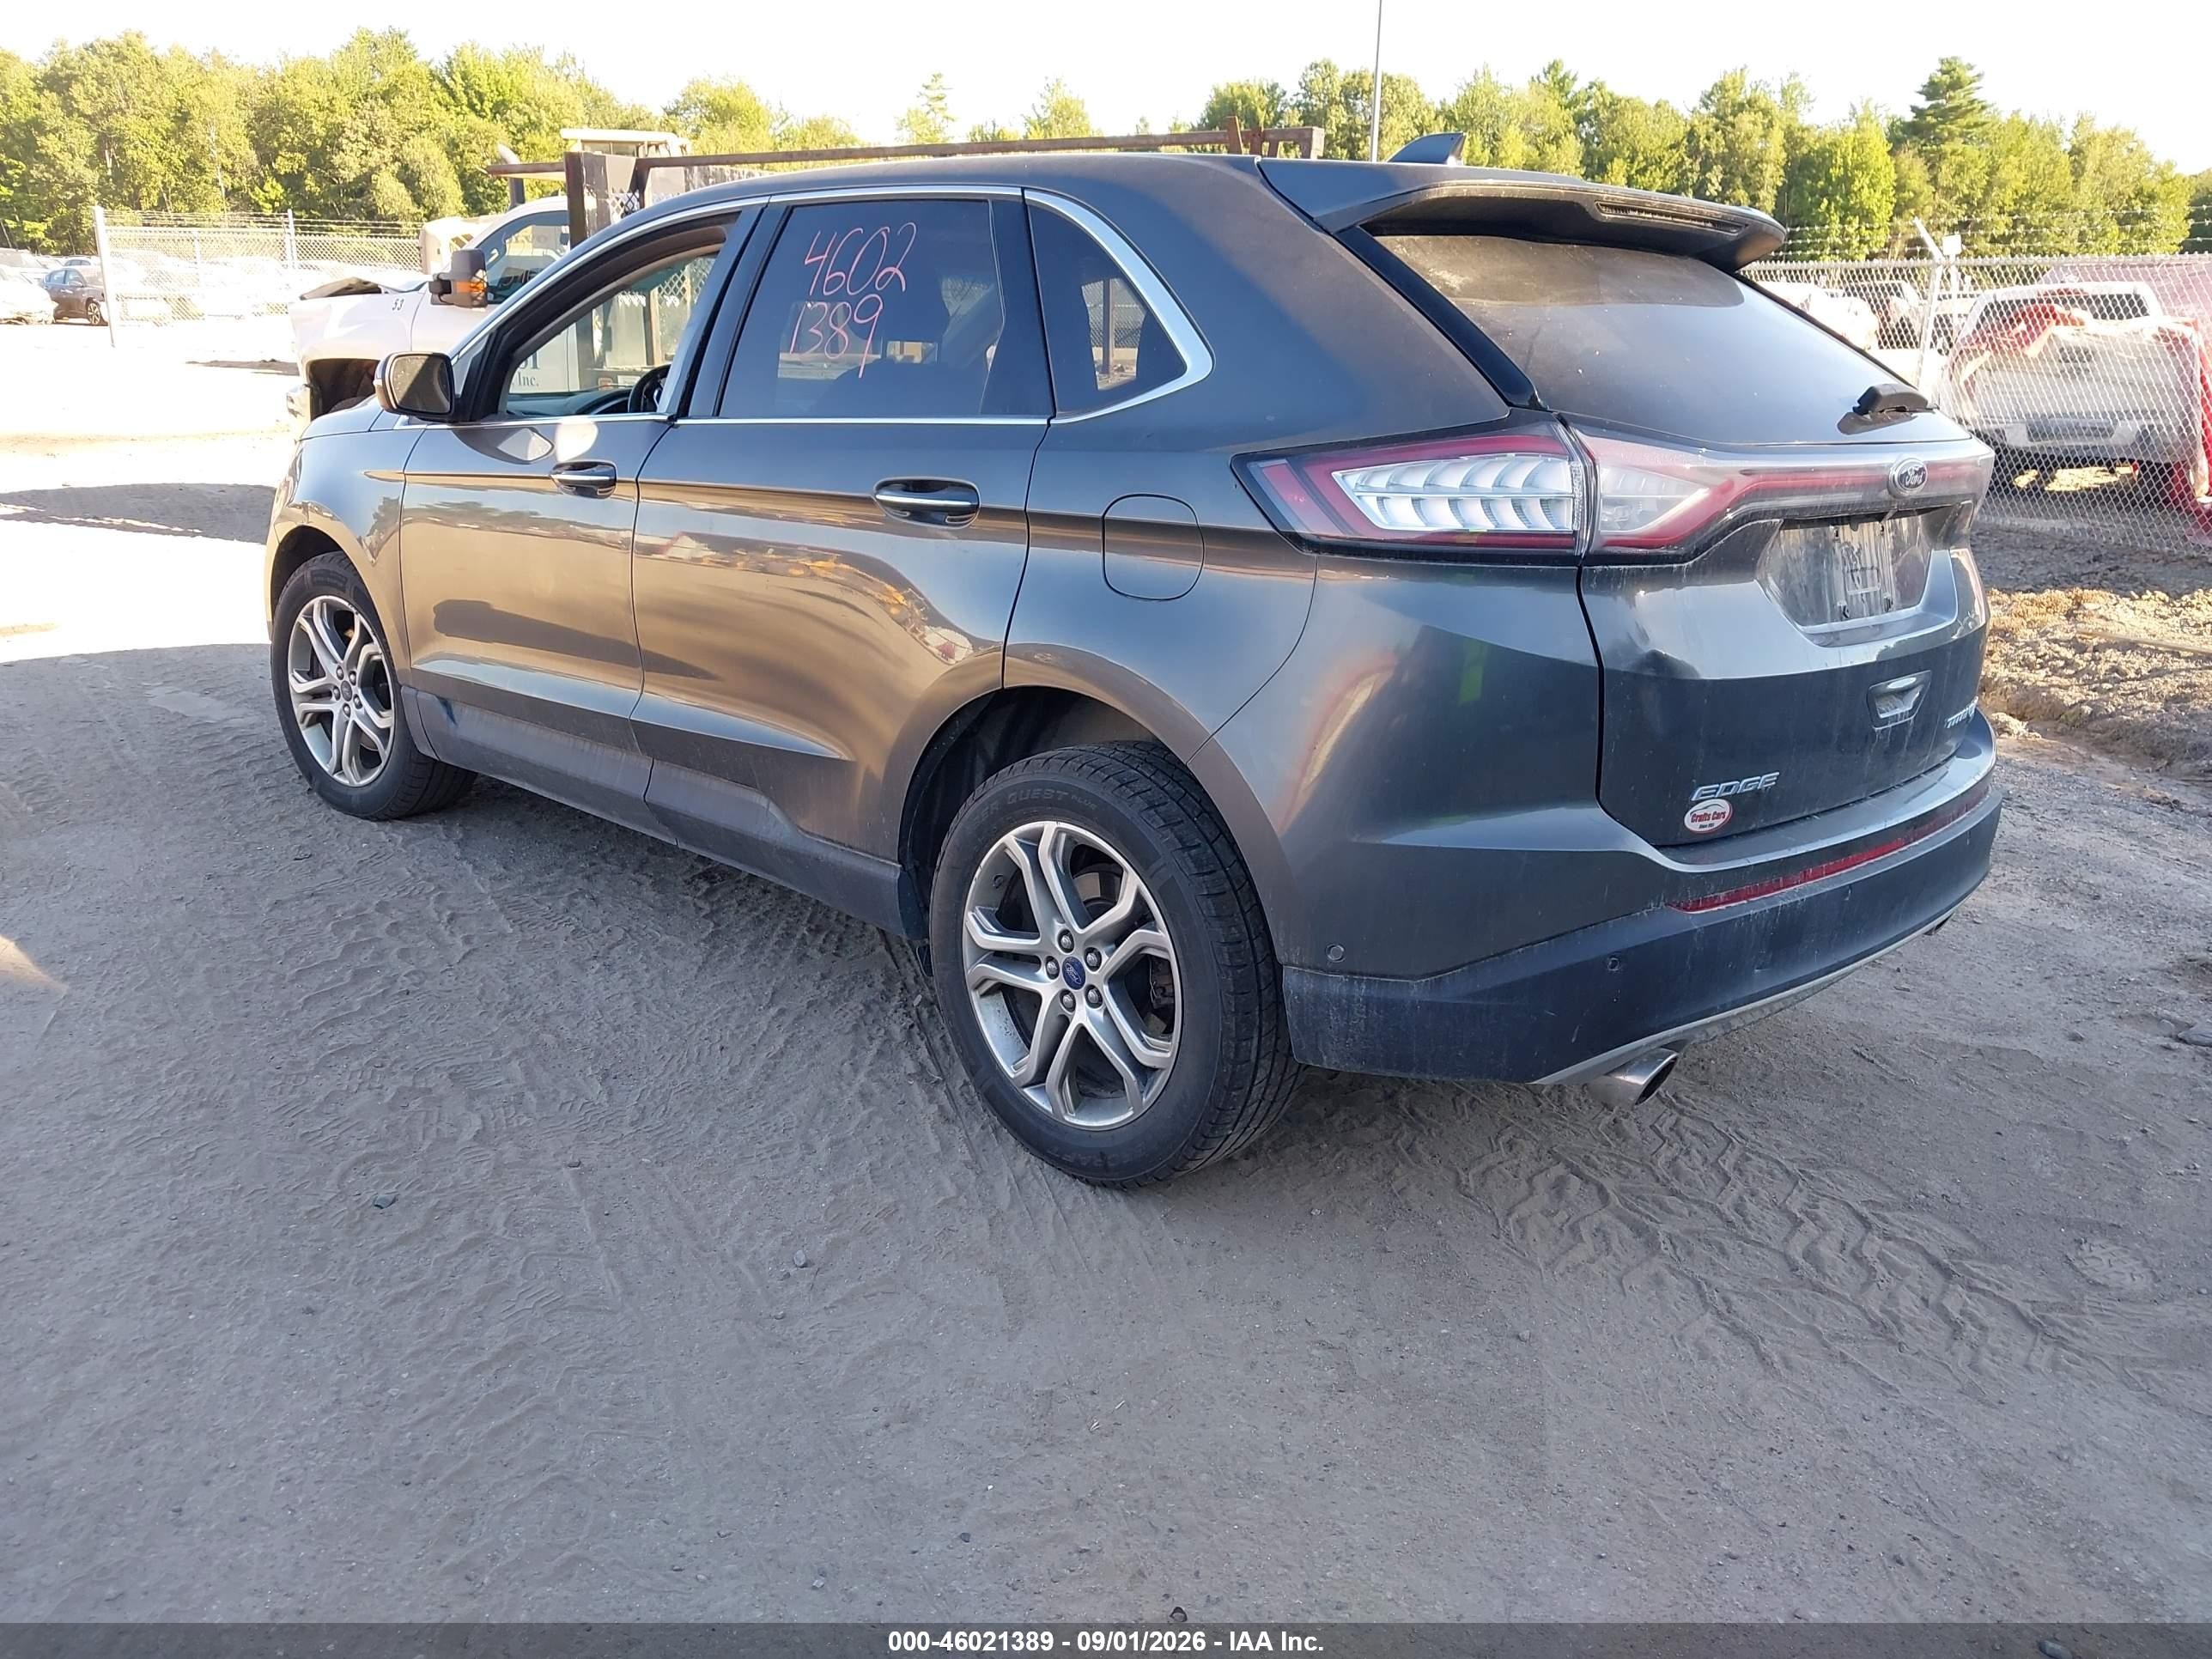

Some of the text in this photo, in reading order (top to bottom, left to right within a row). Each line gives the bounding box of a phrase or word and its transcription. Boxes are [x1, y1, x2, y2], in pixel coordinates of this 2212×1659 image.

[804, 222, 917, 296] 4602
[392, 298, 404, 311] 53
[789, 294, 884, 379] 1389
[517, 371, 539, 387] Inc.
[1899, 465, 1926, 487] Ford
[1690, 771, 1780, 801] EDGE
[1006, 788, 1069, 805] QUEST
[1066, 964, 1081, 983] Ford
